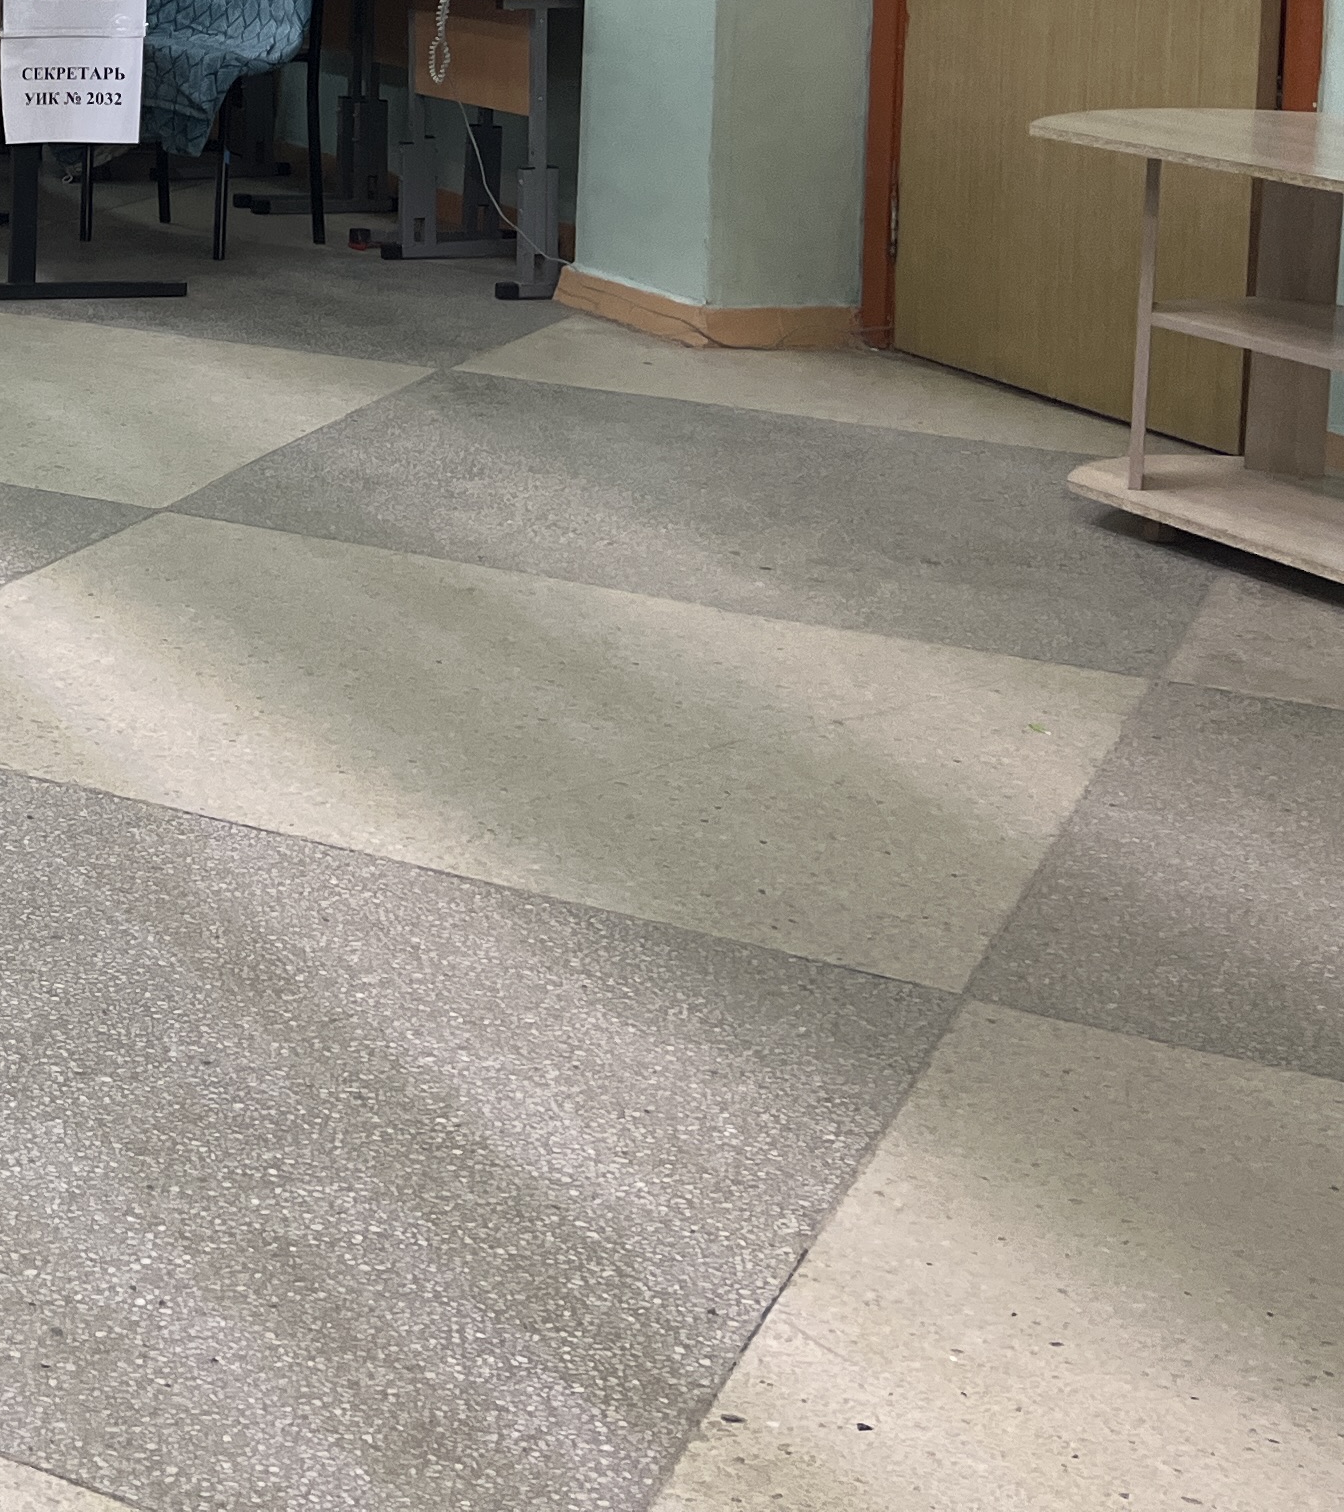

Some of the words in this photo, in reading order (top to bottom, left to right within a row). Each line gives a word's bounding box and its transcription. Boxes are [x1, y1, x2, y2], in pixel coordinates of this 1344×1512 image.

[22, 66, 126, 82] СЕКРЕТАРЬ
[24, 92, 60, 106] УИК
[64, 92, 82, 105] №
[87, 92, 122, 106] 2032
